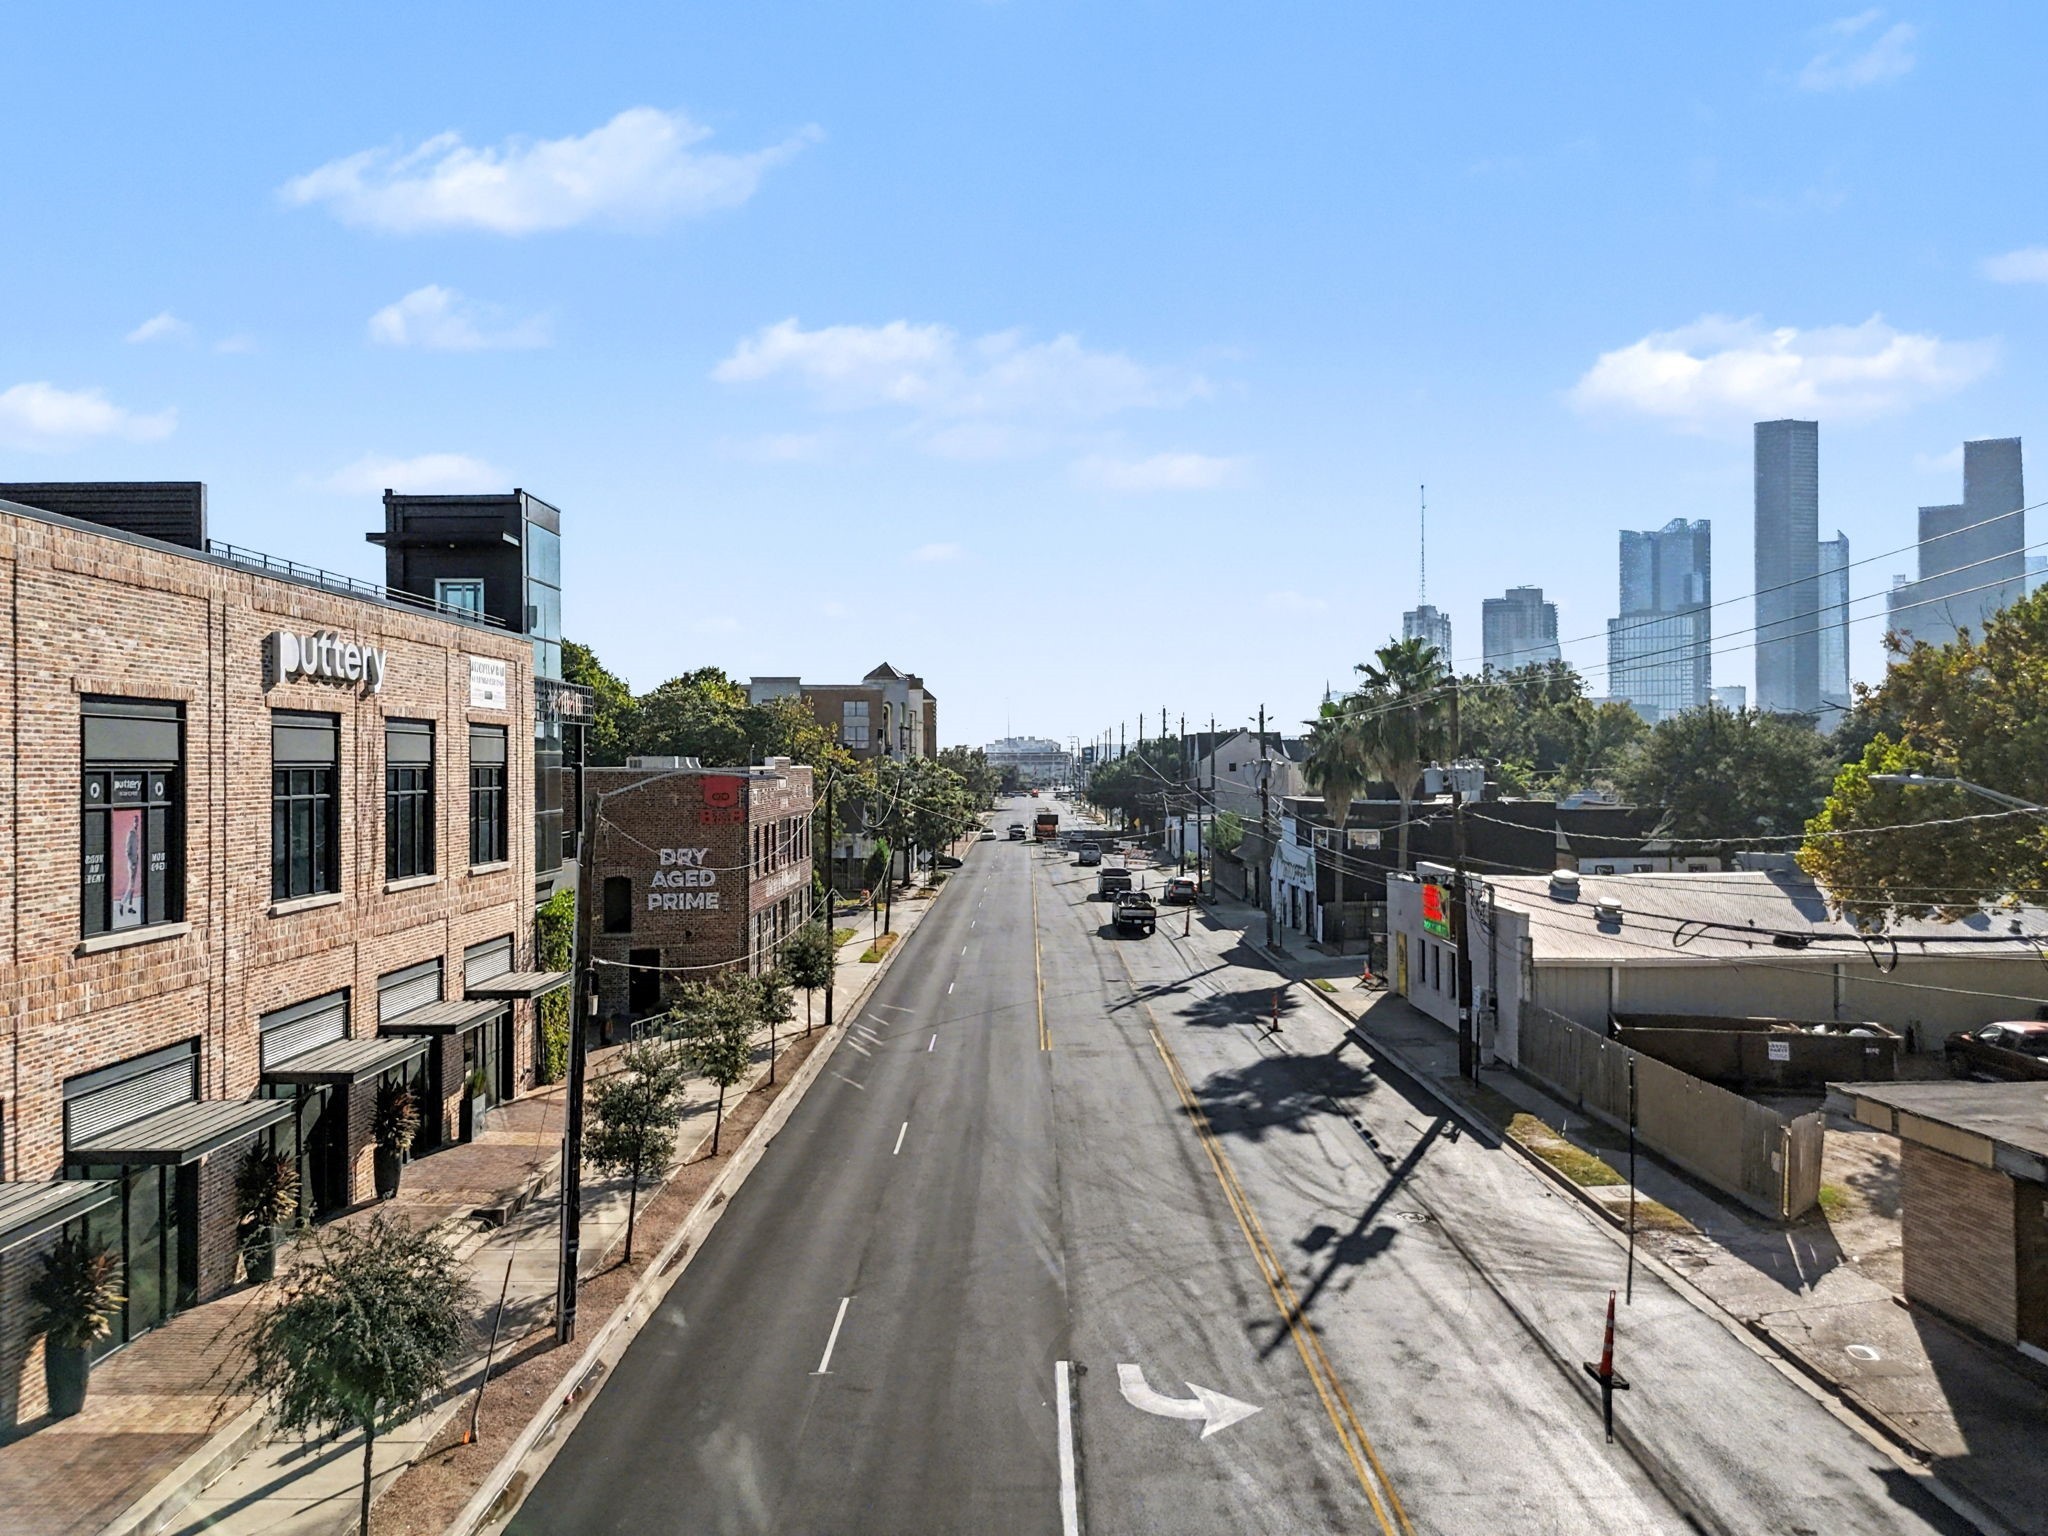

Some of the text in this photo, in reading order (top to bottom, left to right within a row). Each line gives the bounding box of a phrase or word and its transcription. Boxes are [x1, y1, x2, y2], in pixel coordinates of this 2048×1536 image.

[280, 631, 388, 693] puttery
[660, 848, 709, 866] DRY
[650, 870, 716, 887] AGED
[648, 892, 720, 910] PRIME
